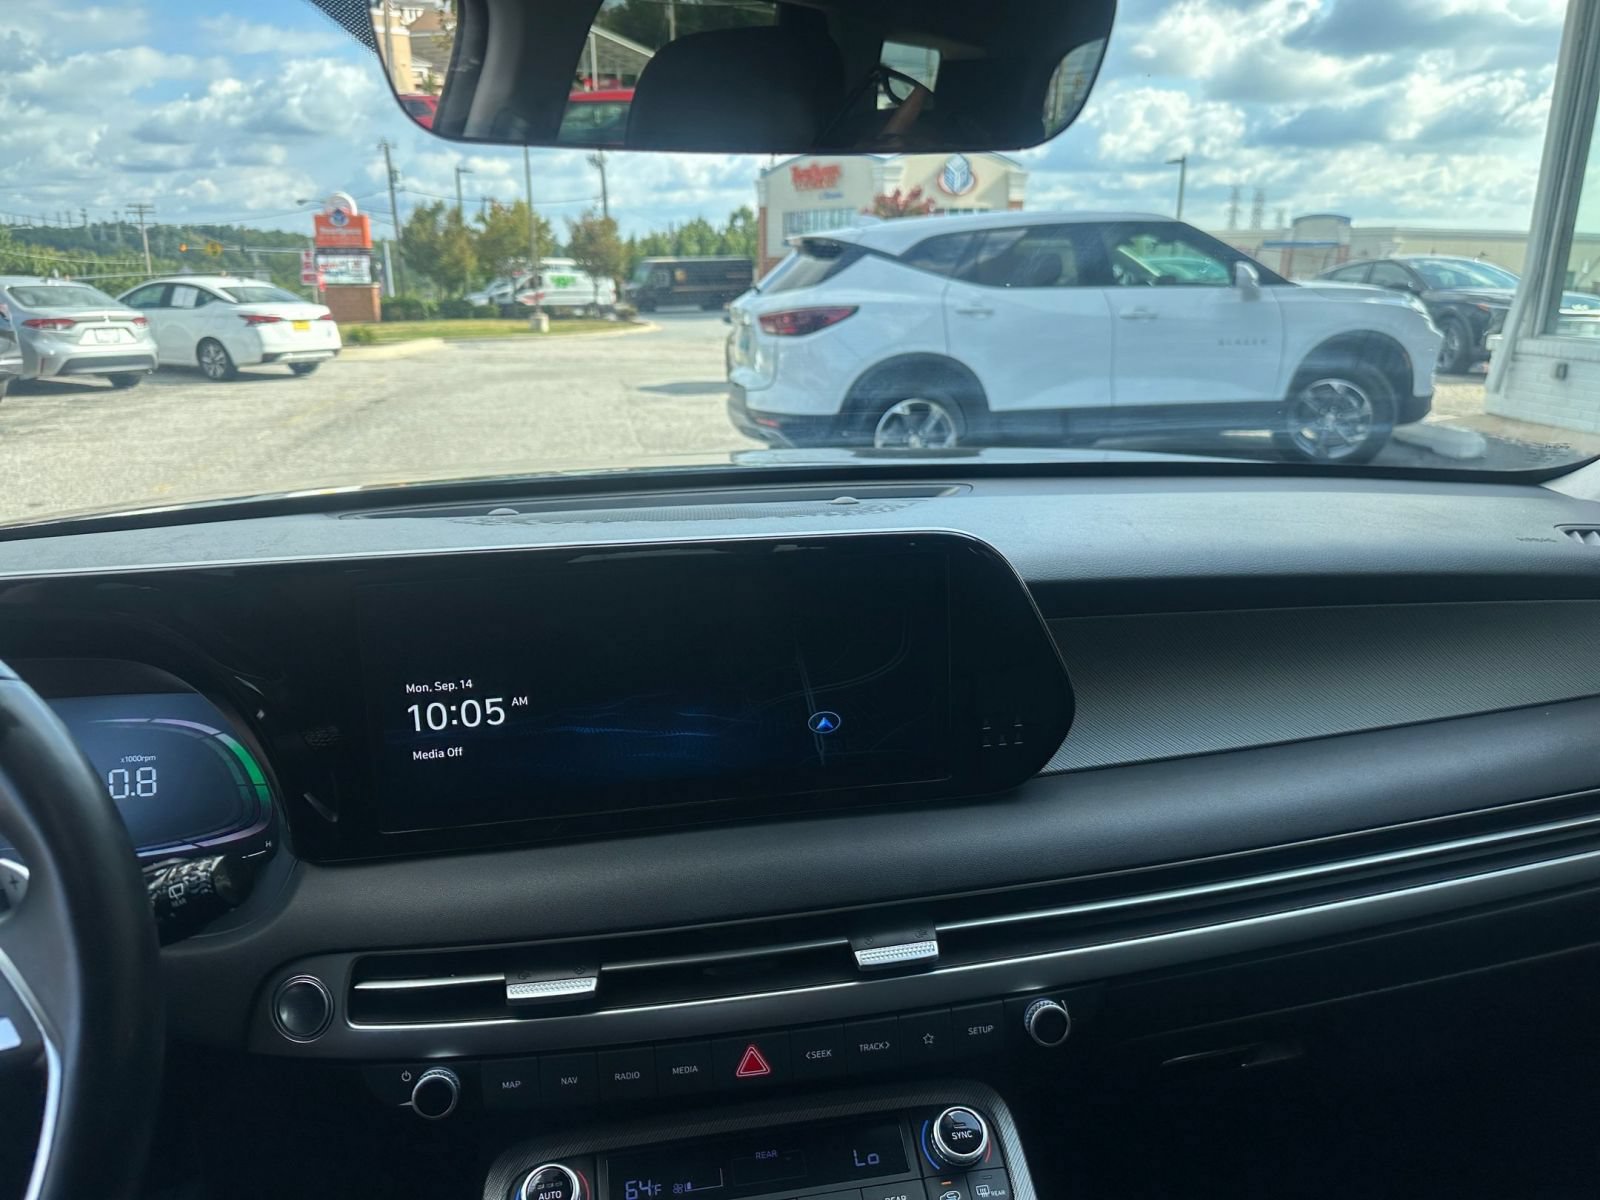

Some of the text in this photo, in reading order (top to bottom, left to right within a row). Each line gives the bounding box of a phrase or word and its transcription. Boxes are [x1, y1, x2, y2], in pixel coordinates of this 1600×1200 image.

[406, 679, 473, 693] Mon. Sep. 14
[407, 696, 529, 732] 10:05 AM
[412, 747, 463, 760] Media Off
[121, 755, 157, 763] x1000rpm
[108, 766, 158, 799] 0.8
[968, 1025, 994, 1036] SETUP
[672, 1064, 699, 1076] MEDIA
[560, 1076, 578, 1086] NAV
[614, 1071, 640, 1081] RADIO
[502, 1080, 521, 1090] MAP
[951, 1130, 973, 1140] SYNC
[755, 1150, 778, 1160] REAR
[538, 1190, 562, 1200] AUTO
